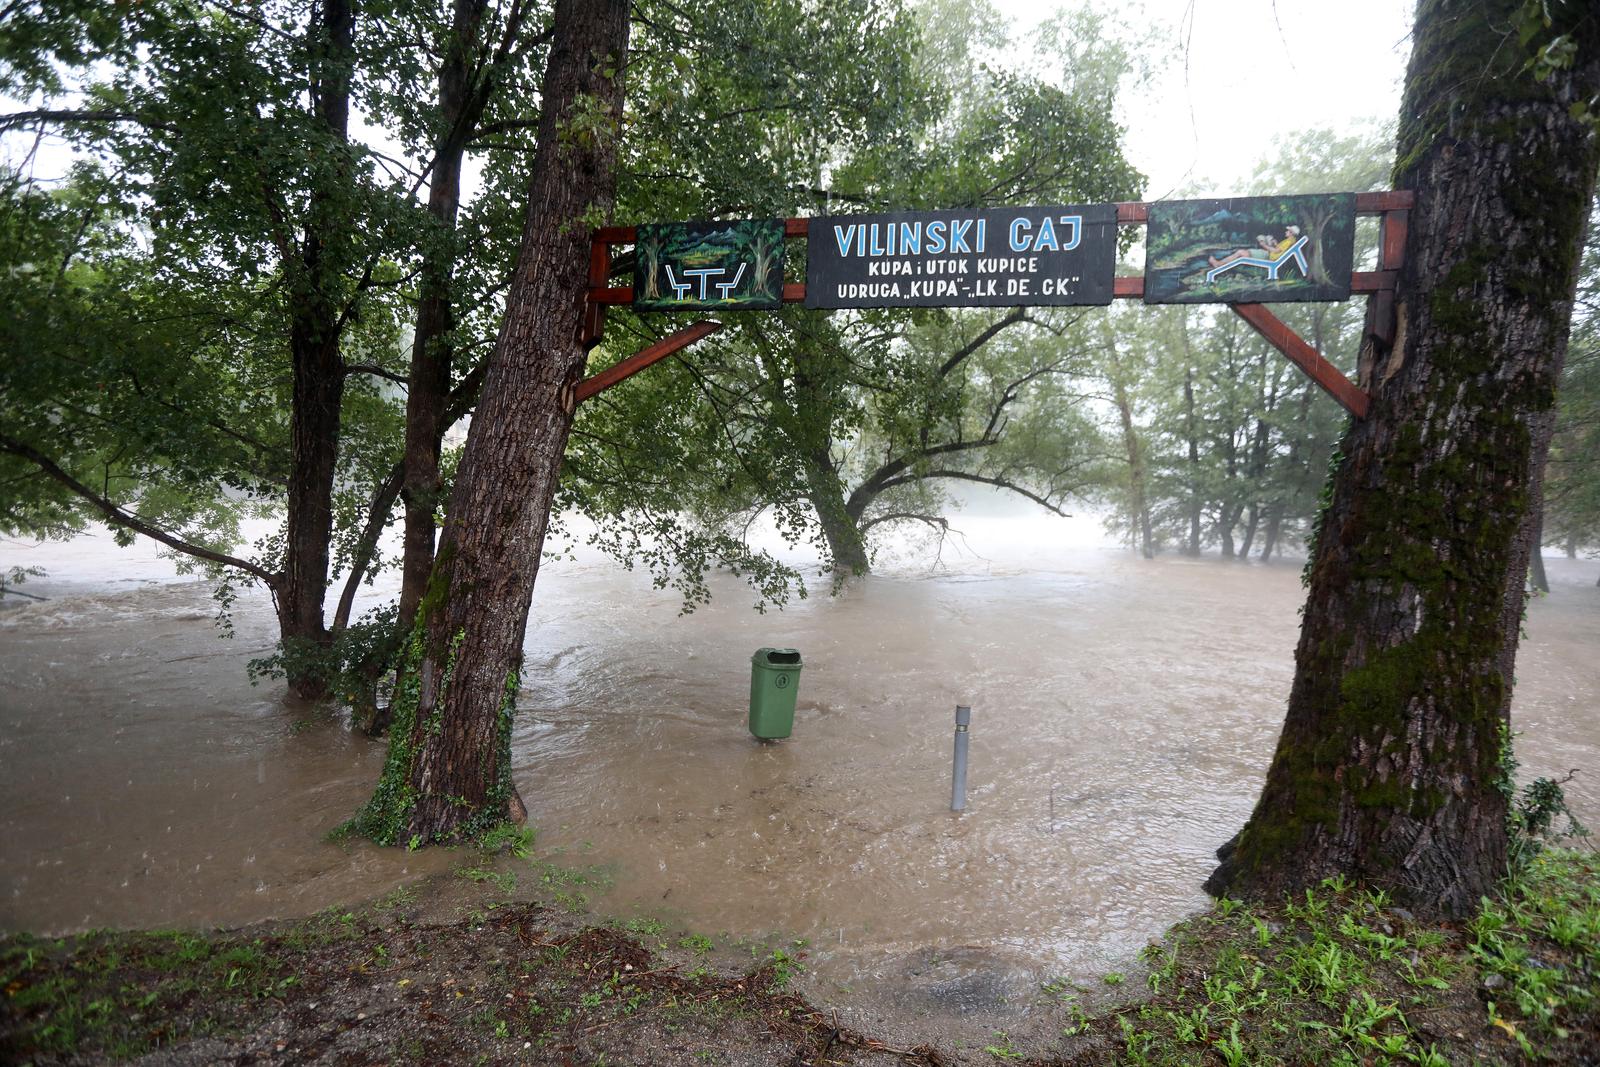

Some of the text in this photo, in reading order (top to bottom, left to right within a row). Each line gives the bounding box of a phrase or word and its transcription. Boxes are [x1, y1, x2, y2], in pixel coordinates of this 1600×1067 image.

[833, 215, 1083, 257] VILINSKI GAJ
[868, 260, 912, 276] KUPA
[926, 260, 968, 274] UTOK
[977, 257, 1038, 273] KUPICE
[838, 284, 900, 299] UDRUGA
